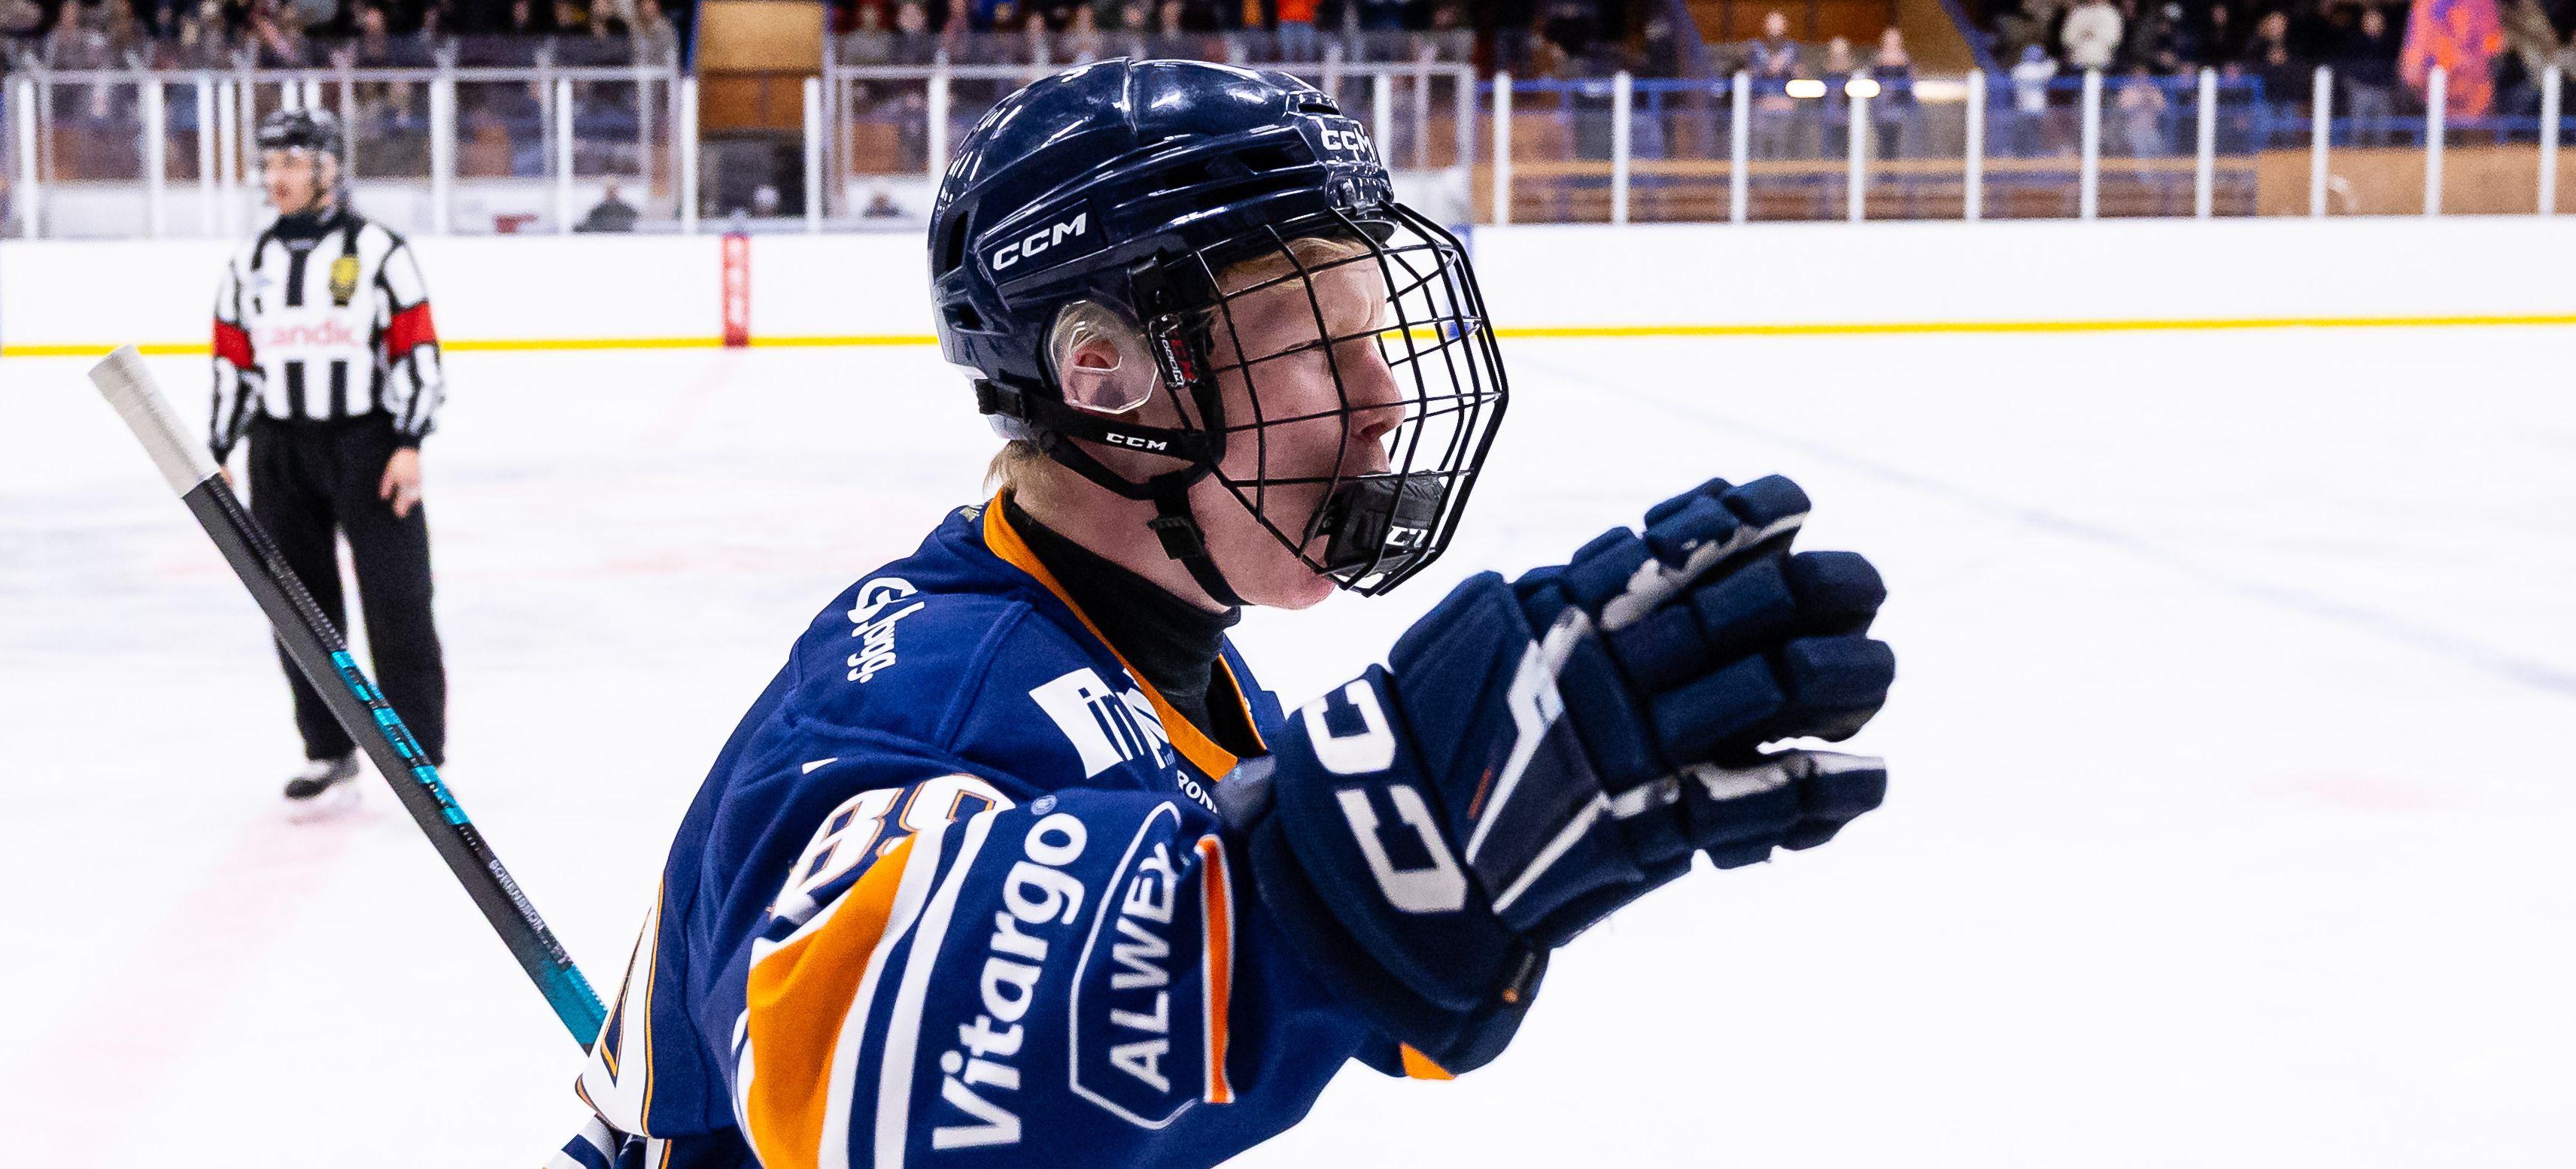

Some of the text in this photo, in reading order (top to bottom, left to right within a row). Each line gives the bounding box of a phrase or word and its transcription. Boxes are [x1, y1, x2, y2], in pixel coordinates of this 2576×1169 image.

[1321, 126, 1377, 161] CCM
[993, 212, 1086, 270] CCM
[1106, 432, 1168, 451] CCM
[932, 812, 1088, 1151] Vitargo
